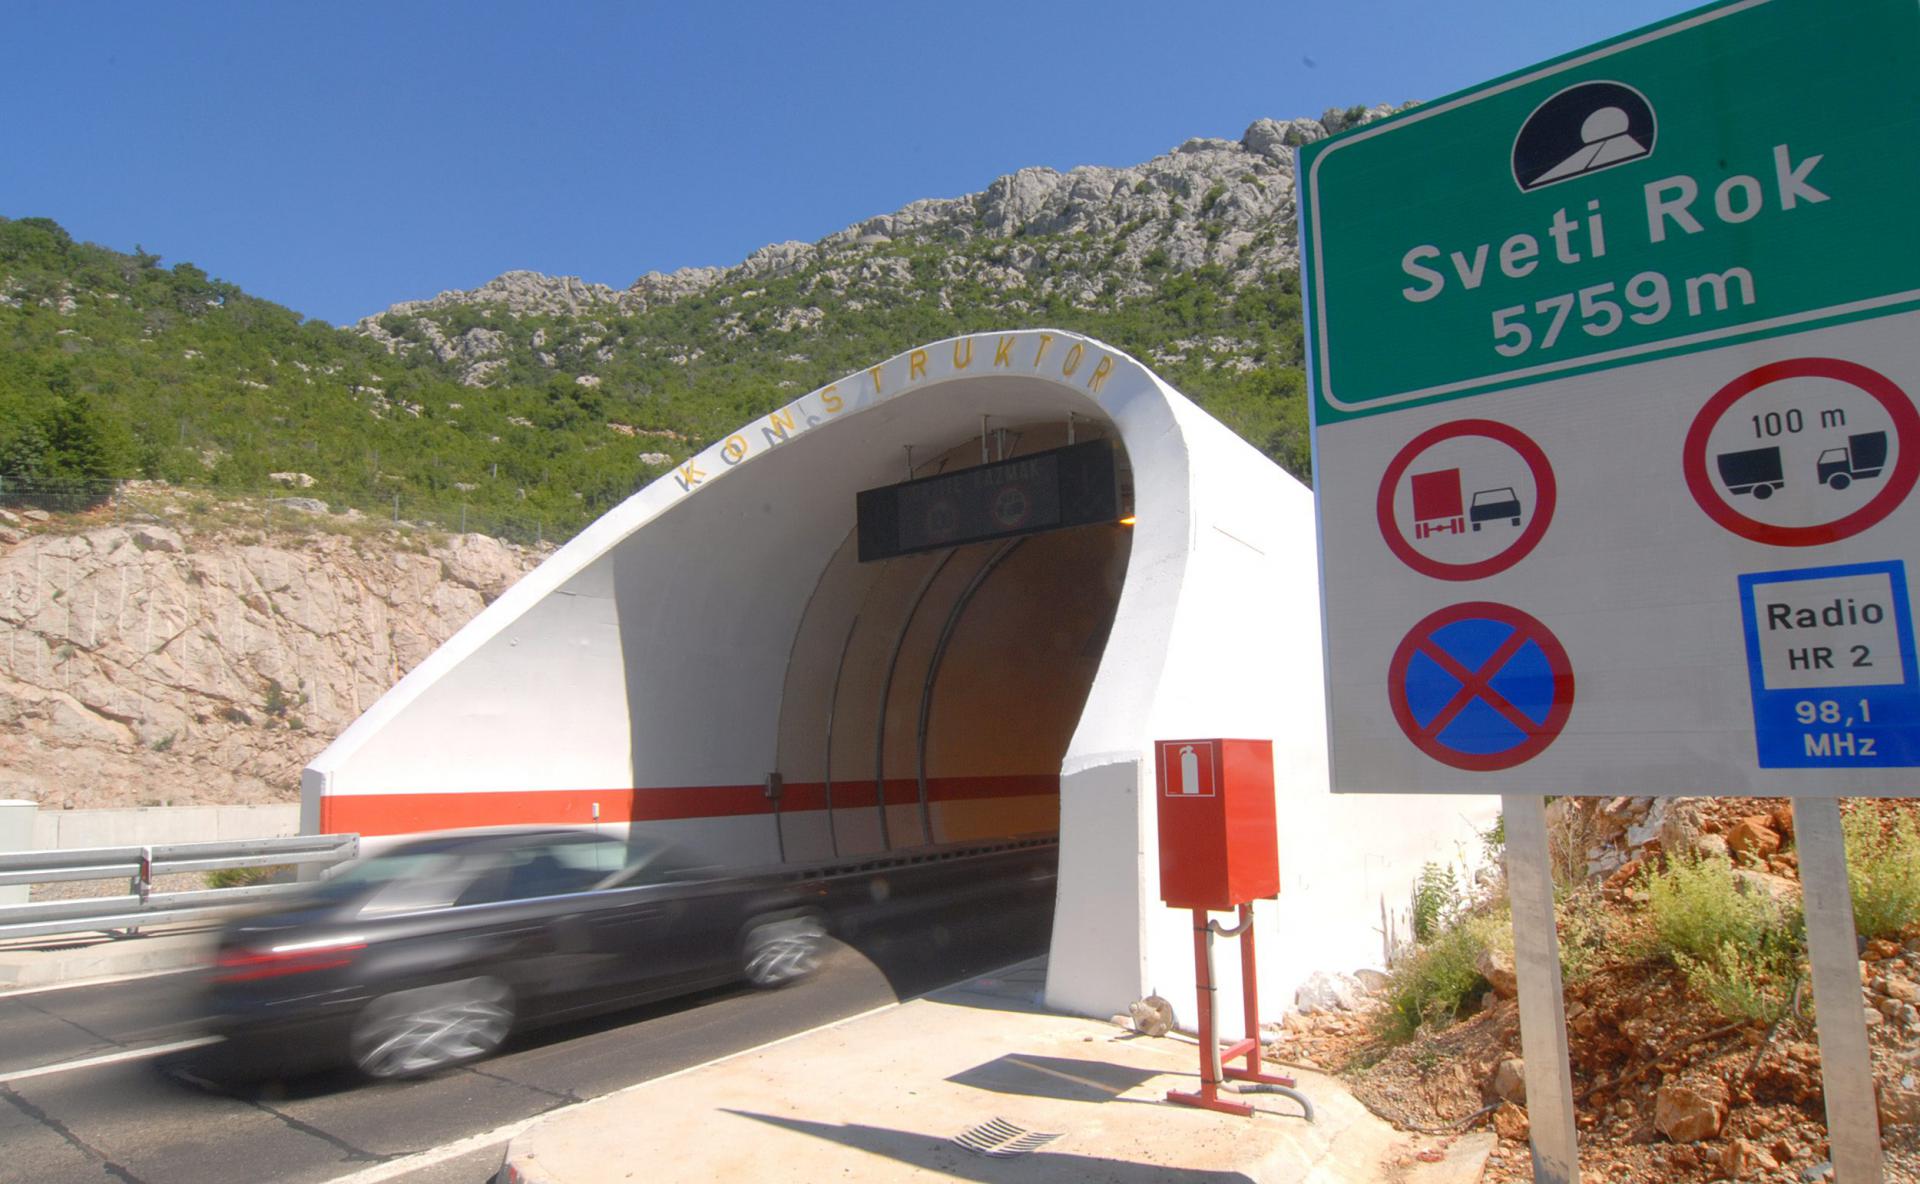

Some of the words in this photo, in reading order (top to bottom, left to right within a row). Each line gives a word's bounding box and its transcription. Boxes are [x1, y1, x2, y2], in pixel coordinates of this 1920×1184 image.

[1402, 199, 1606, 302] Sveti
[1644, 144, 1831, 243] Rok
[680, 334, 1114, 486] KONSTRUKTOR
[1752, 409, 1804, 438] 100
[1821, 408, 1846, 428] m
[1767, 600, 1884, 630] Radio
[1789, 647, 1834, 670] HR
[1851, 645, 1873, 667] 2
[1795, 699, 1871, 727] 98,1
[1804, 733, 1877, 757] MHz
